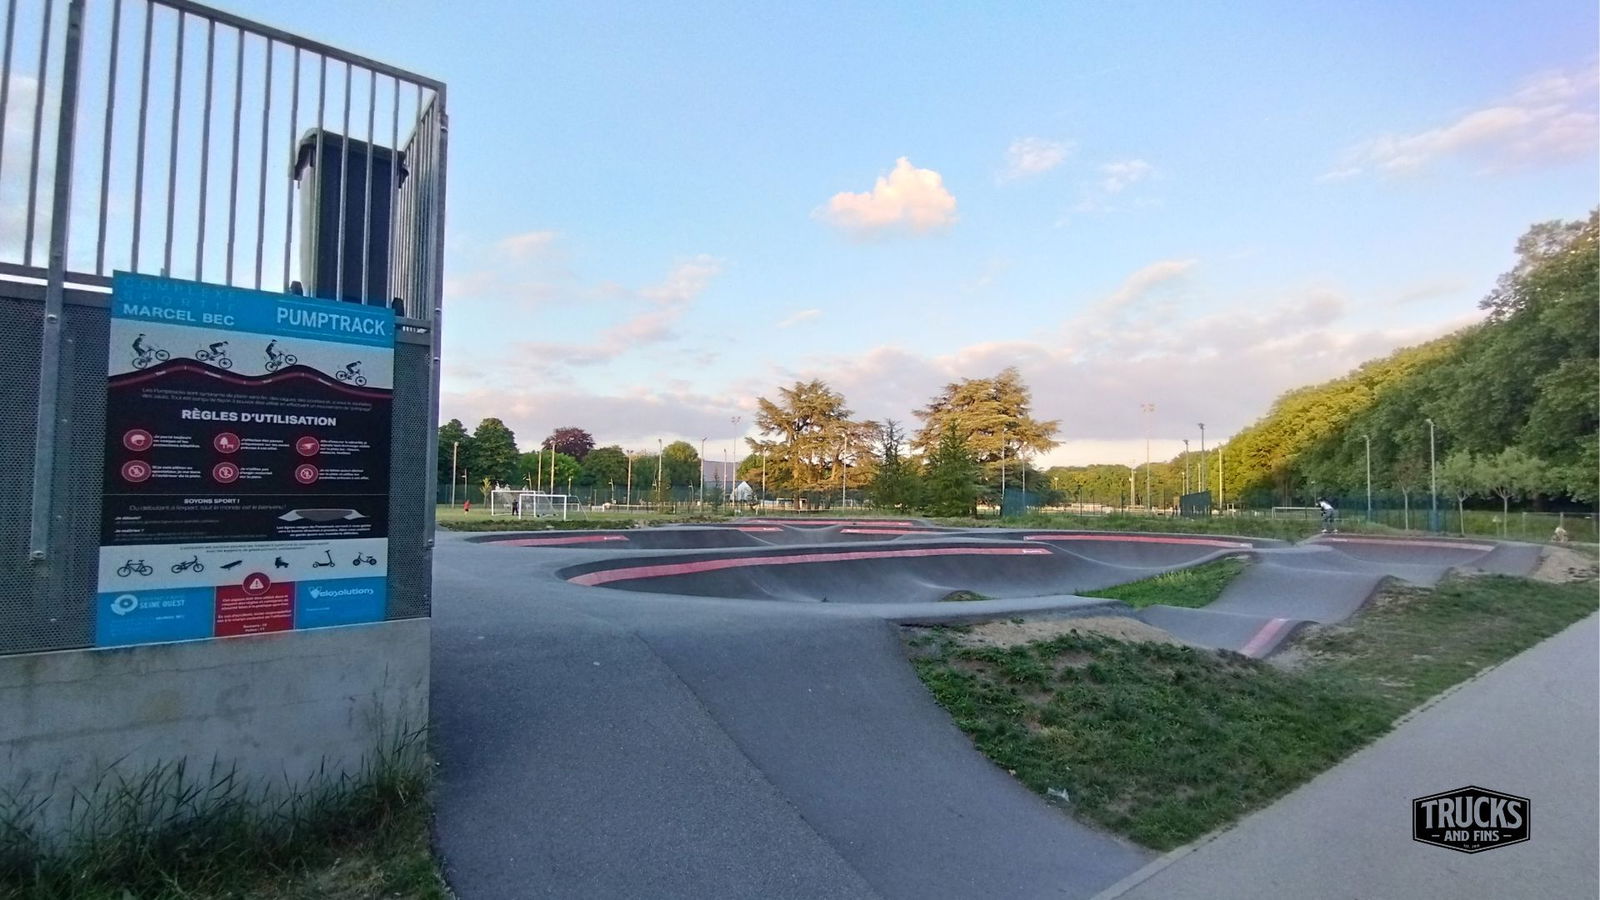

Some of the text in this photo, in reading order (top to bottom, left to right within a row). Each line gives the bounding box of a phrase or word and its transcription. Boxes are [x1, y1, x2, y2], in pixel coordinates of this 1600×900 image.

[123, 303, 235, 326] MARCEL BEC
[276, 306, 386, 336] PUMPTRACK
[181, 407, 337, 427] RÈGLES D'UTILISATION
[161, 598, 185, 608] OUEST
